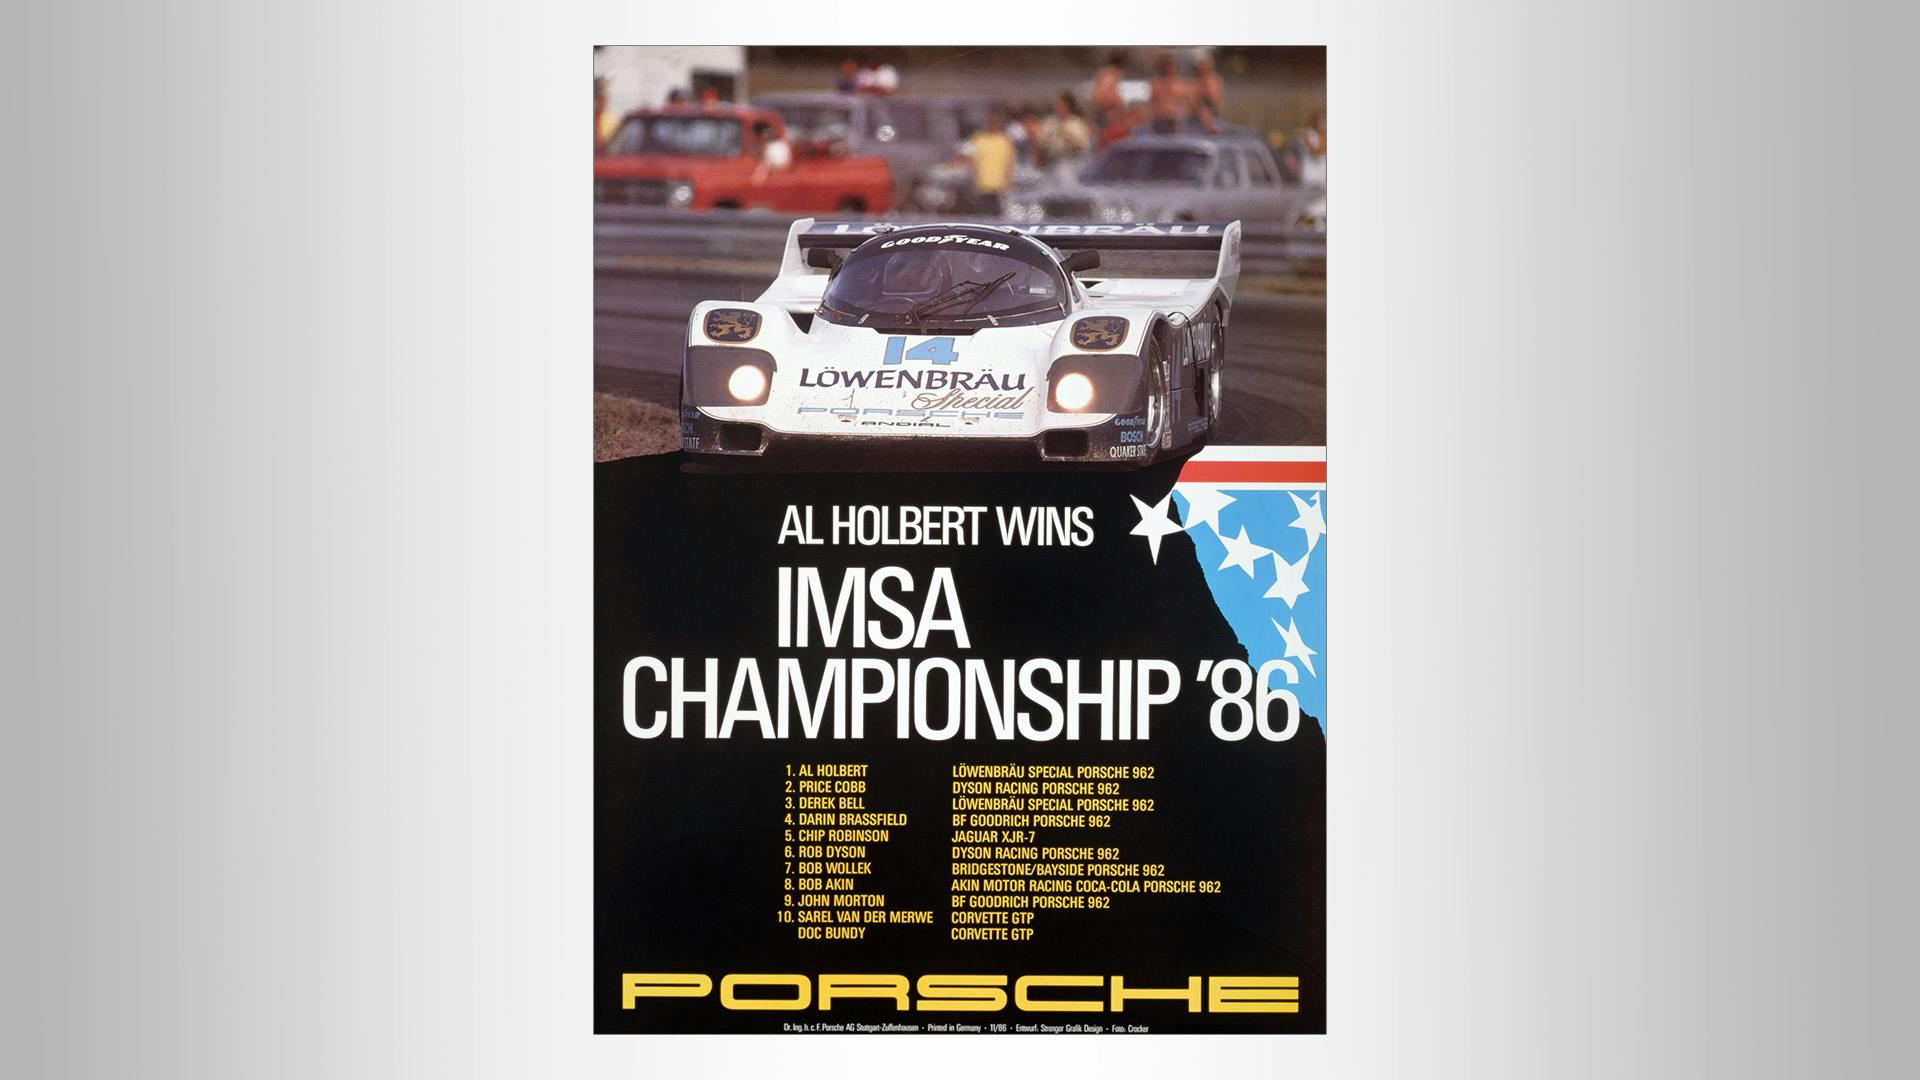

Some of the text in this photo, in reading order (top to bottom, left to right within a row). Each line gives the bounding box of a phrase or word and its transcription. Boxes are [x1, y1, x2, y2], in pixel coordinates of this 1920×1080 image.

[883, 336, 959, 365] 14
[800, 366, 1026, 391] LÖWENBRÄU
[911, 386, 1034, 410] Special
[797, 407, 1024, 420] PORSCHE
[778, 505, 1094, 546] AL HOLBERT WINS
[778, 566, 971, 649] IMSA
[622, 656, 1301, 742] CHAMPIONSHIP '86
[786, 764, 868, 777] 1. AL HOLBERT
[953, 763, 1154, 779] LÖWENBRÄU SPECIAL PORSCHE 962
[785, 781, 866, 793] 2. PRICE COBB
[953, 782, 1119, 795] DYSON RACING PORSCHE 962
[785, 797, 865, 809] 3. DEREK BELL
[953, 795, 1154, 811] LÖWENBRÄU SPECIAL PORSCHE 962
[784, 813, 907, 825] 4. DARIN BRASSFIELD
[953, 814, 1110, 827] BF GOODRICH PORSCHE 962
[785, 829, 888, 842] 5. CHIP ROBINSON
[952, 830, 1035, 843] JAGUAR XJR-7
[785, 846, 865, 858] 6. ROB DYSON
[952, 847, 1119, 860] DYSON RACING PORSCHE 962
[785, 862, 871, 874] 7. BOB WOLLEK
[952, 863, 1164, 876] BRIDGESTONE/BAYSIDE PORSCHE 962
[784, 878, 853, 890] 8. BOB AKIN
[951, 879, 1221, 893] AKIN MOTOR RACING COCA-COLA PORSCHE 962
[784, 894, 884, 907] 9. JOHN MORTON
[952, 895, 1109, 908] BF GOODRICH PORSCHE 962
[778, 911, 933, 923] 10. SAREL VAN DER MERWE
[952, 911, 1034, 924] CORVETTE GTP
[798, 927, 865, 939] DOC BUNDY
[951, 928, 1034, 940] CORVETTE GTP
[622, 974, 1299, 1012] PORSCHE
[846, 1024, 855, 1032] AG
[857, 1023, 919, 1033] Stuttgart-Zuffenhausen
[928, 1024, 947, 1032] Printed
[956, 1024, 981, 1033] Germany
[1066, 1024, 1082, 1032] Grafik
[1084, 1024, 1103, 1033] Design
